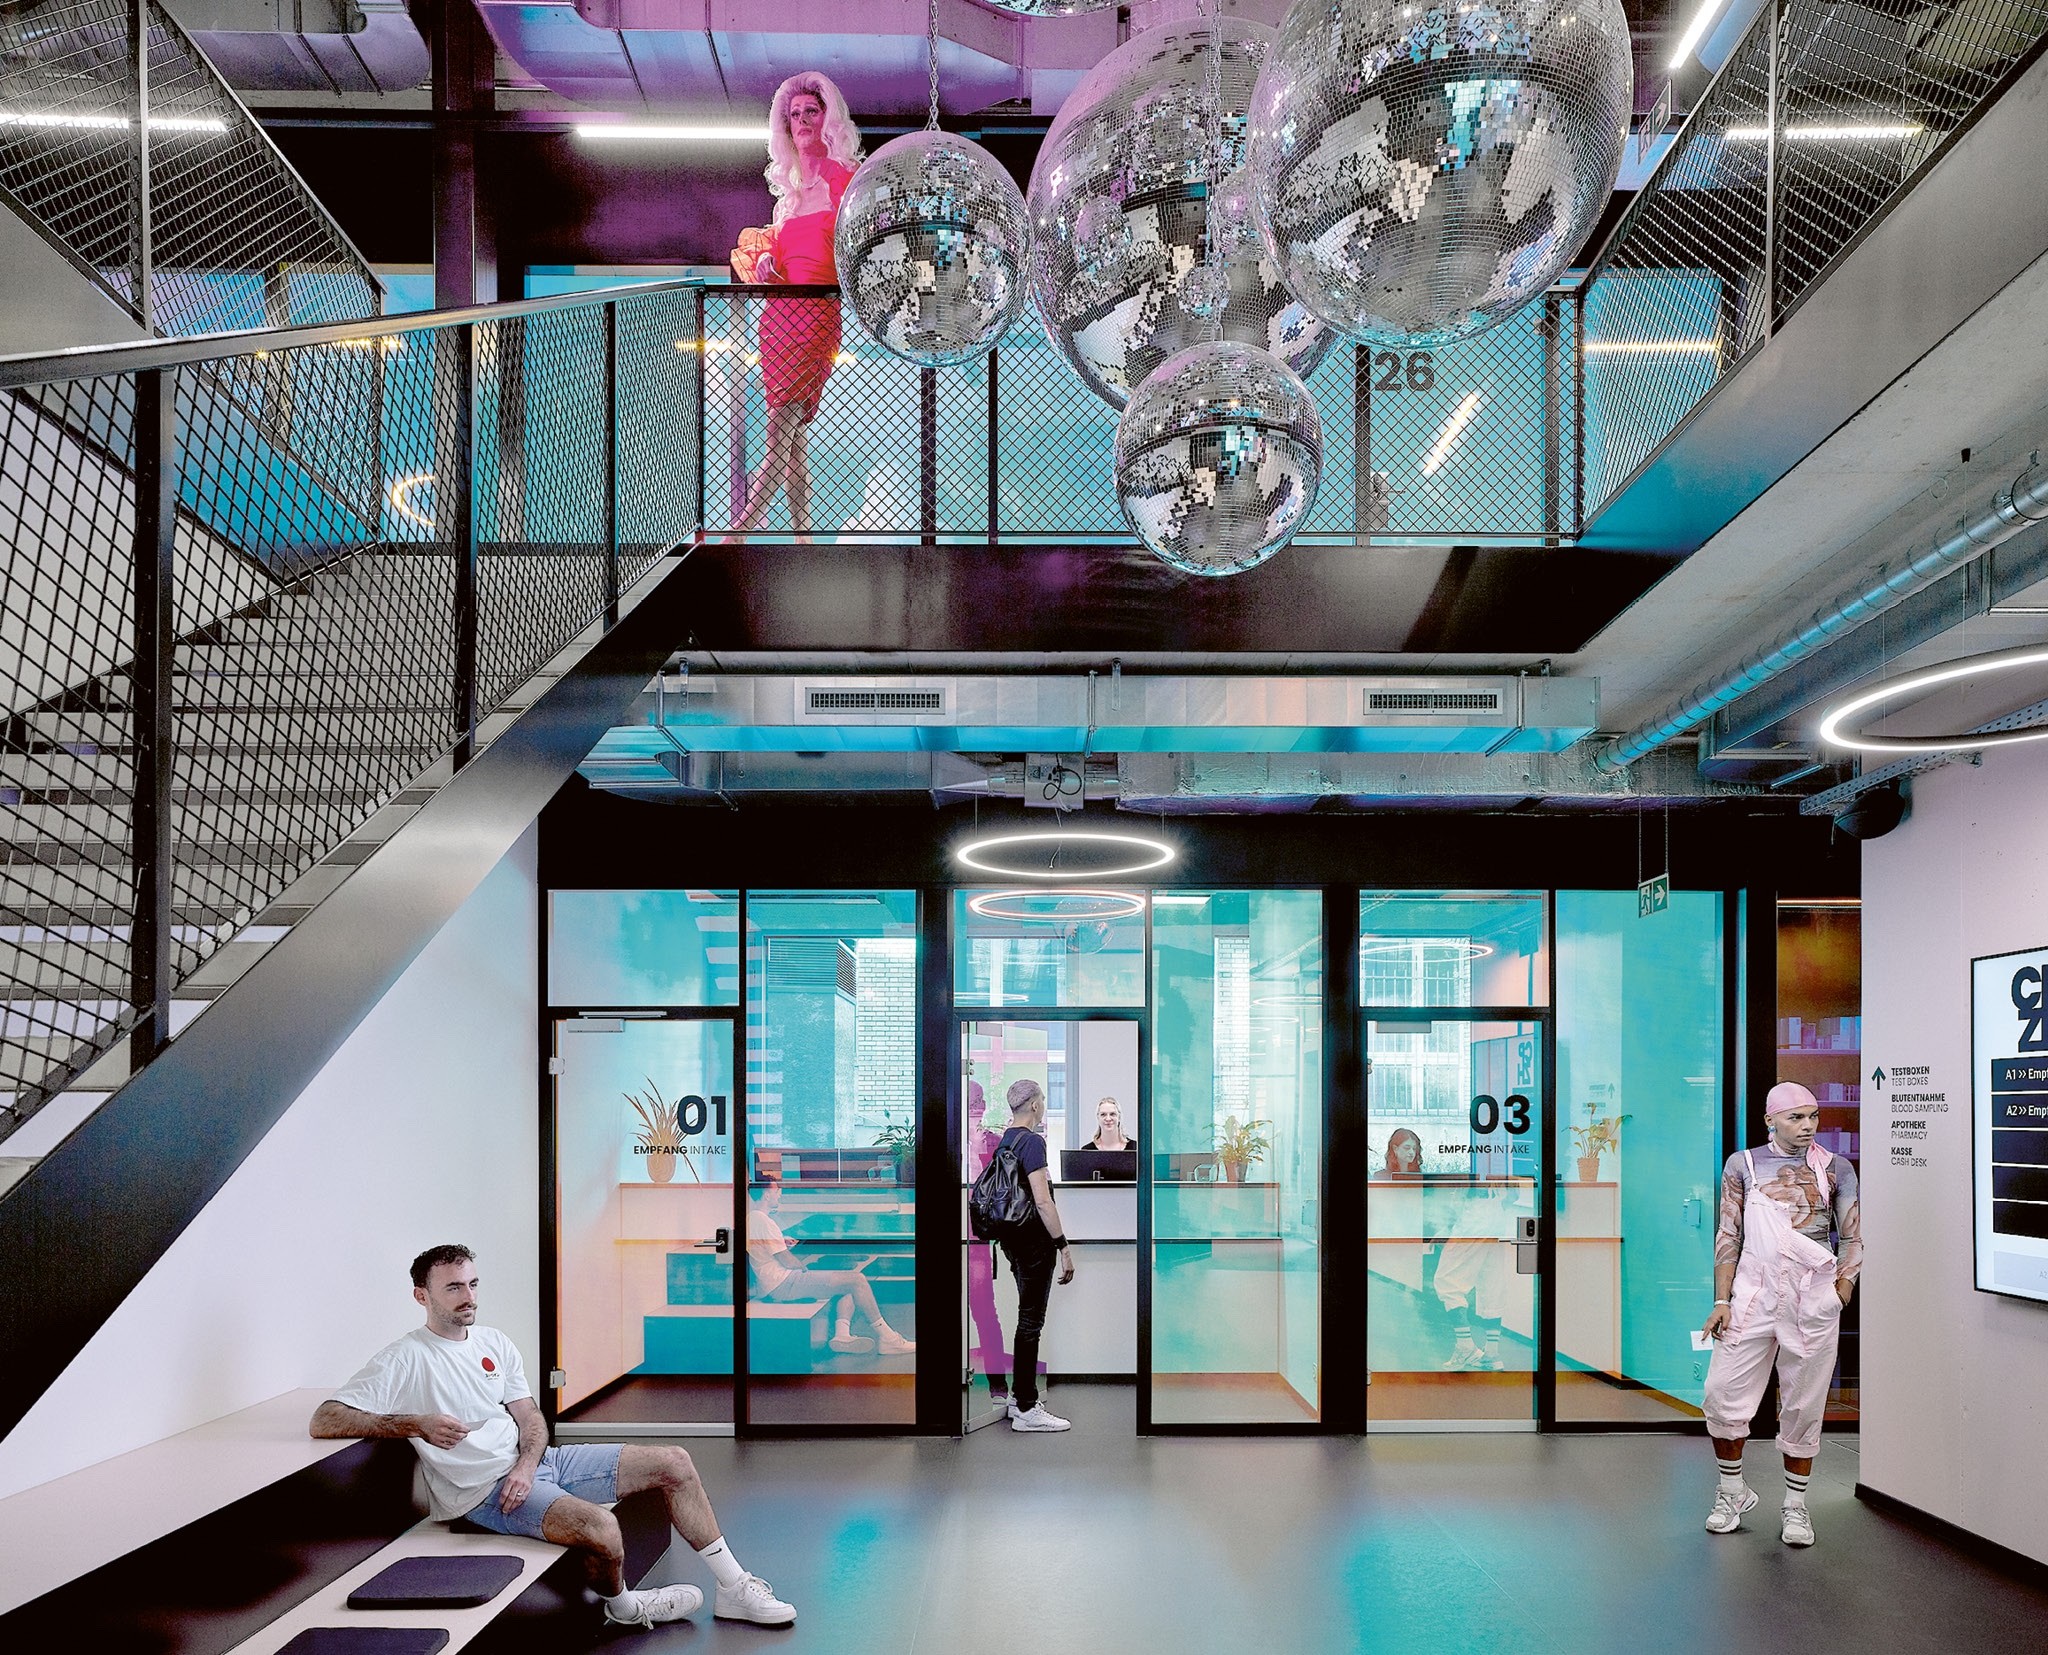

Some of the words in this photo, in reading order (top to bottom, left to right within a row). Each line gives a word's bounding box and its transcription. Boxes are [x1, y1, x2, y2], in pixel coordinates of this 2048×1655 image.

[1375, 352, 1434, 391] 26
[2011, 964, 2048, 1010] C
[1891, 1066, 1930, 1076] TESTBOXEN
[2005, 1068, 2016, 1080] A1
[1891, 1077, 1906, 1086] TEST
[1907, 1076, 1929, 1086] BOXES
[1891, 1093, 1945, 1102] BLUTENTNAHME
[1891, 1103, 1914, 1113] BLOOD
[1914, 1103, 1949, 1113] SAMPLING
[2006, 1105, 2018, 1116] A2
[677, 1095, 726, 1135] 01
[1470, 1095, 1530, 1135] 03
[1891, 1120, 1927, 1129] APOTHEKE
[1891, 1130, 1928, 1140] PHARMACY
[634, 1145, 688, 1155] EMPFANG
[690, 1145, 727, 1155] INTAKE
[1438, 1144, 1492, 1154] EMPFANG
[1494, 1144, 1530, 1154] INTAKE
[1891, 1147, 1913, 1156] KASSE
[1891, 1157, 1910, 1166] CASH
[1911, 1157, 1927, 1167] DESK
